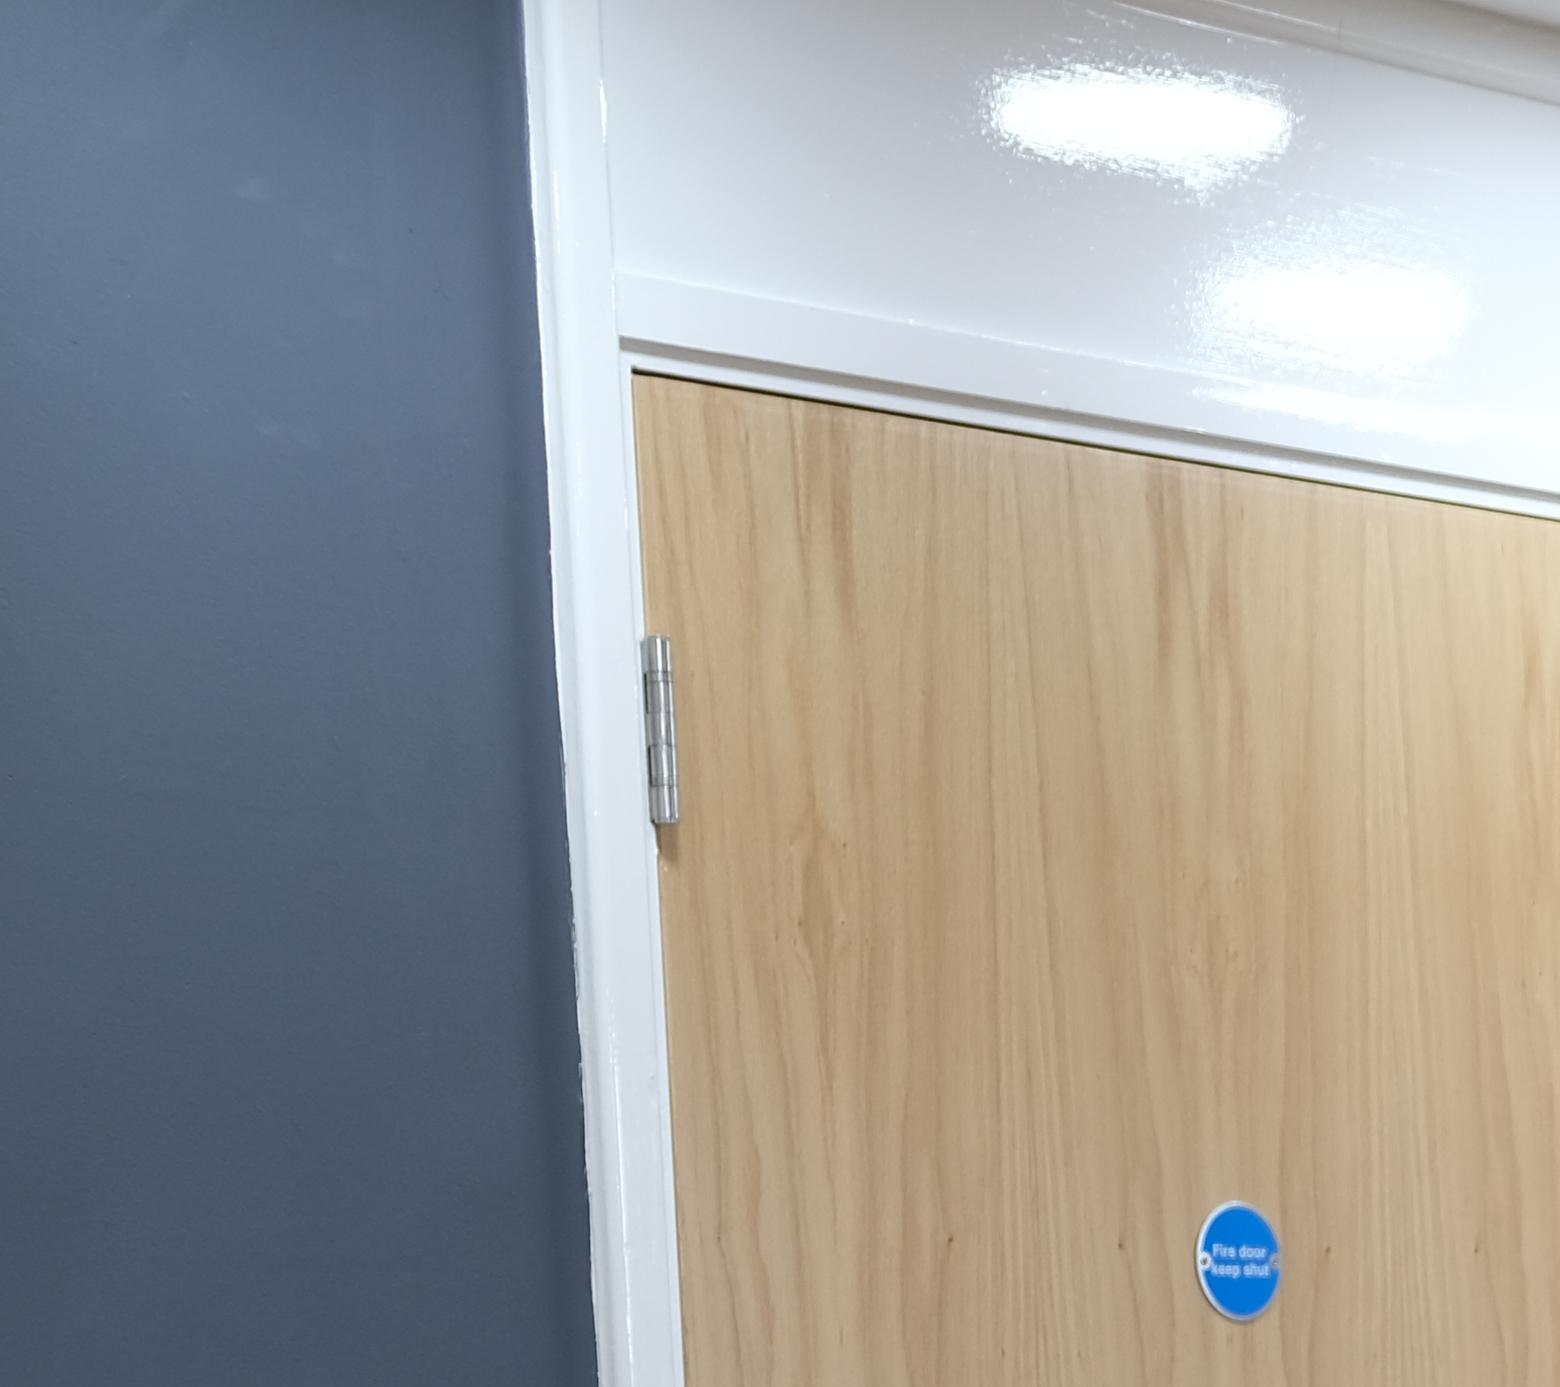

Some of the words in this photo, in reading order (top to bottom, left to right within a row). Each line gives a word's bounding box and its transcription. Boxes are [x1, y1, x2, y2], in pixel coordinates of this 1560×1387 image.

[1212, 1244, 1235, 1257] Fire
[1238, 1245, 1267, 1258] door
[1211, 1263, 1240, 1279] keep
[1243, 1263, 1269, 1276] shut
